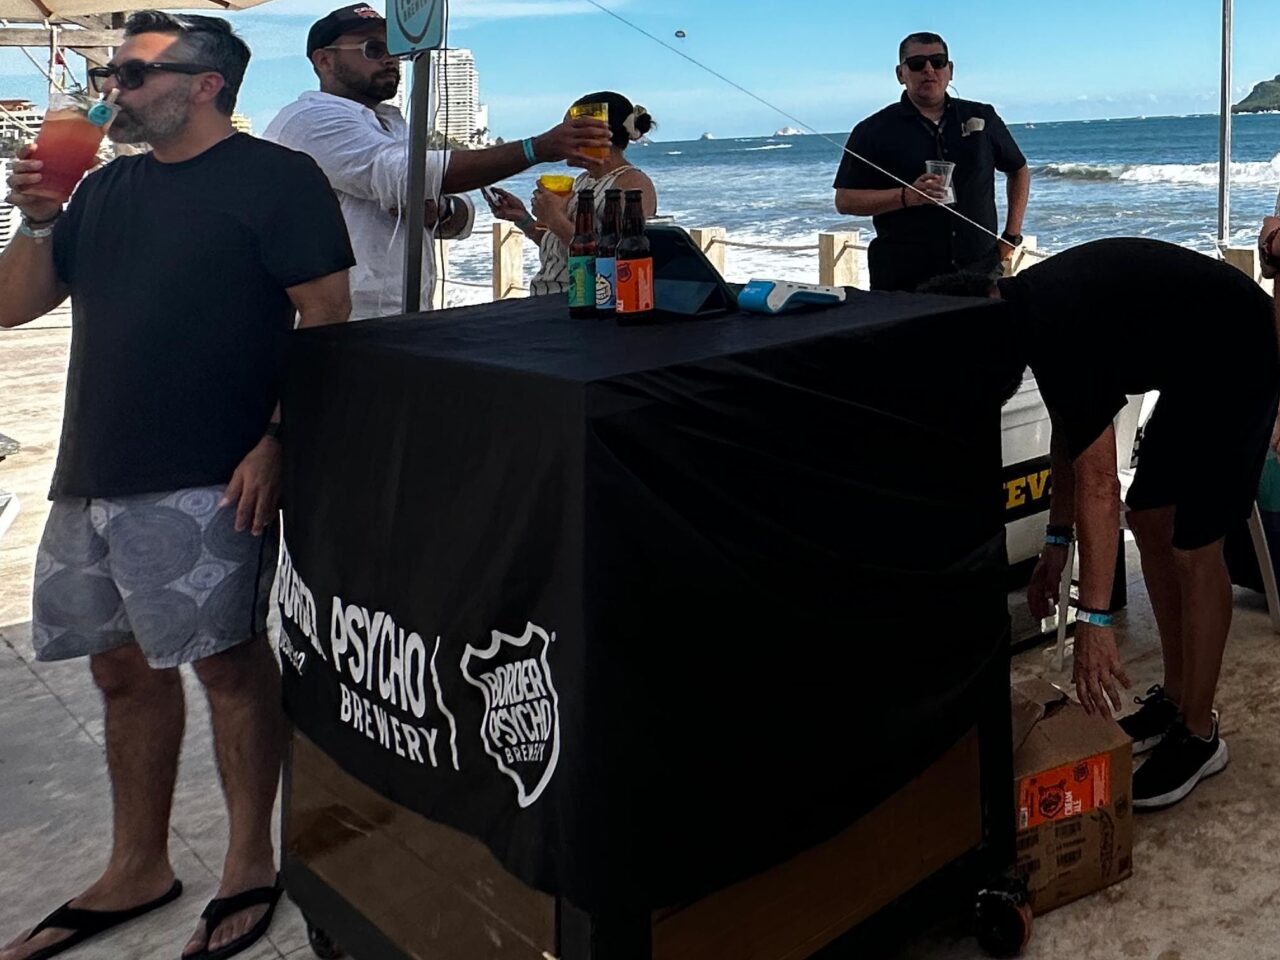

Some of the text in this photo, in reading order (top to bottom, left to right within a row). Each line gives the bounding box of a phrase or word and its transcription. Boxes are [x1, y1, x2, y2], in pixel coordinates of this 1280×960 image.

[1002, 469, 1053, 510] EV
[331, 596, 426, 718] PSYCHO
[480, 658, 547, 708] BORDER
[340, 682, 438, 768] BREWERY
[489, 698, 552, 747] PSYCHO
